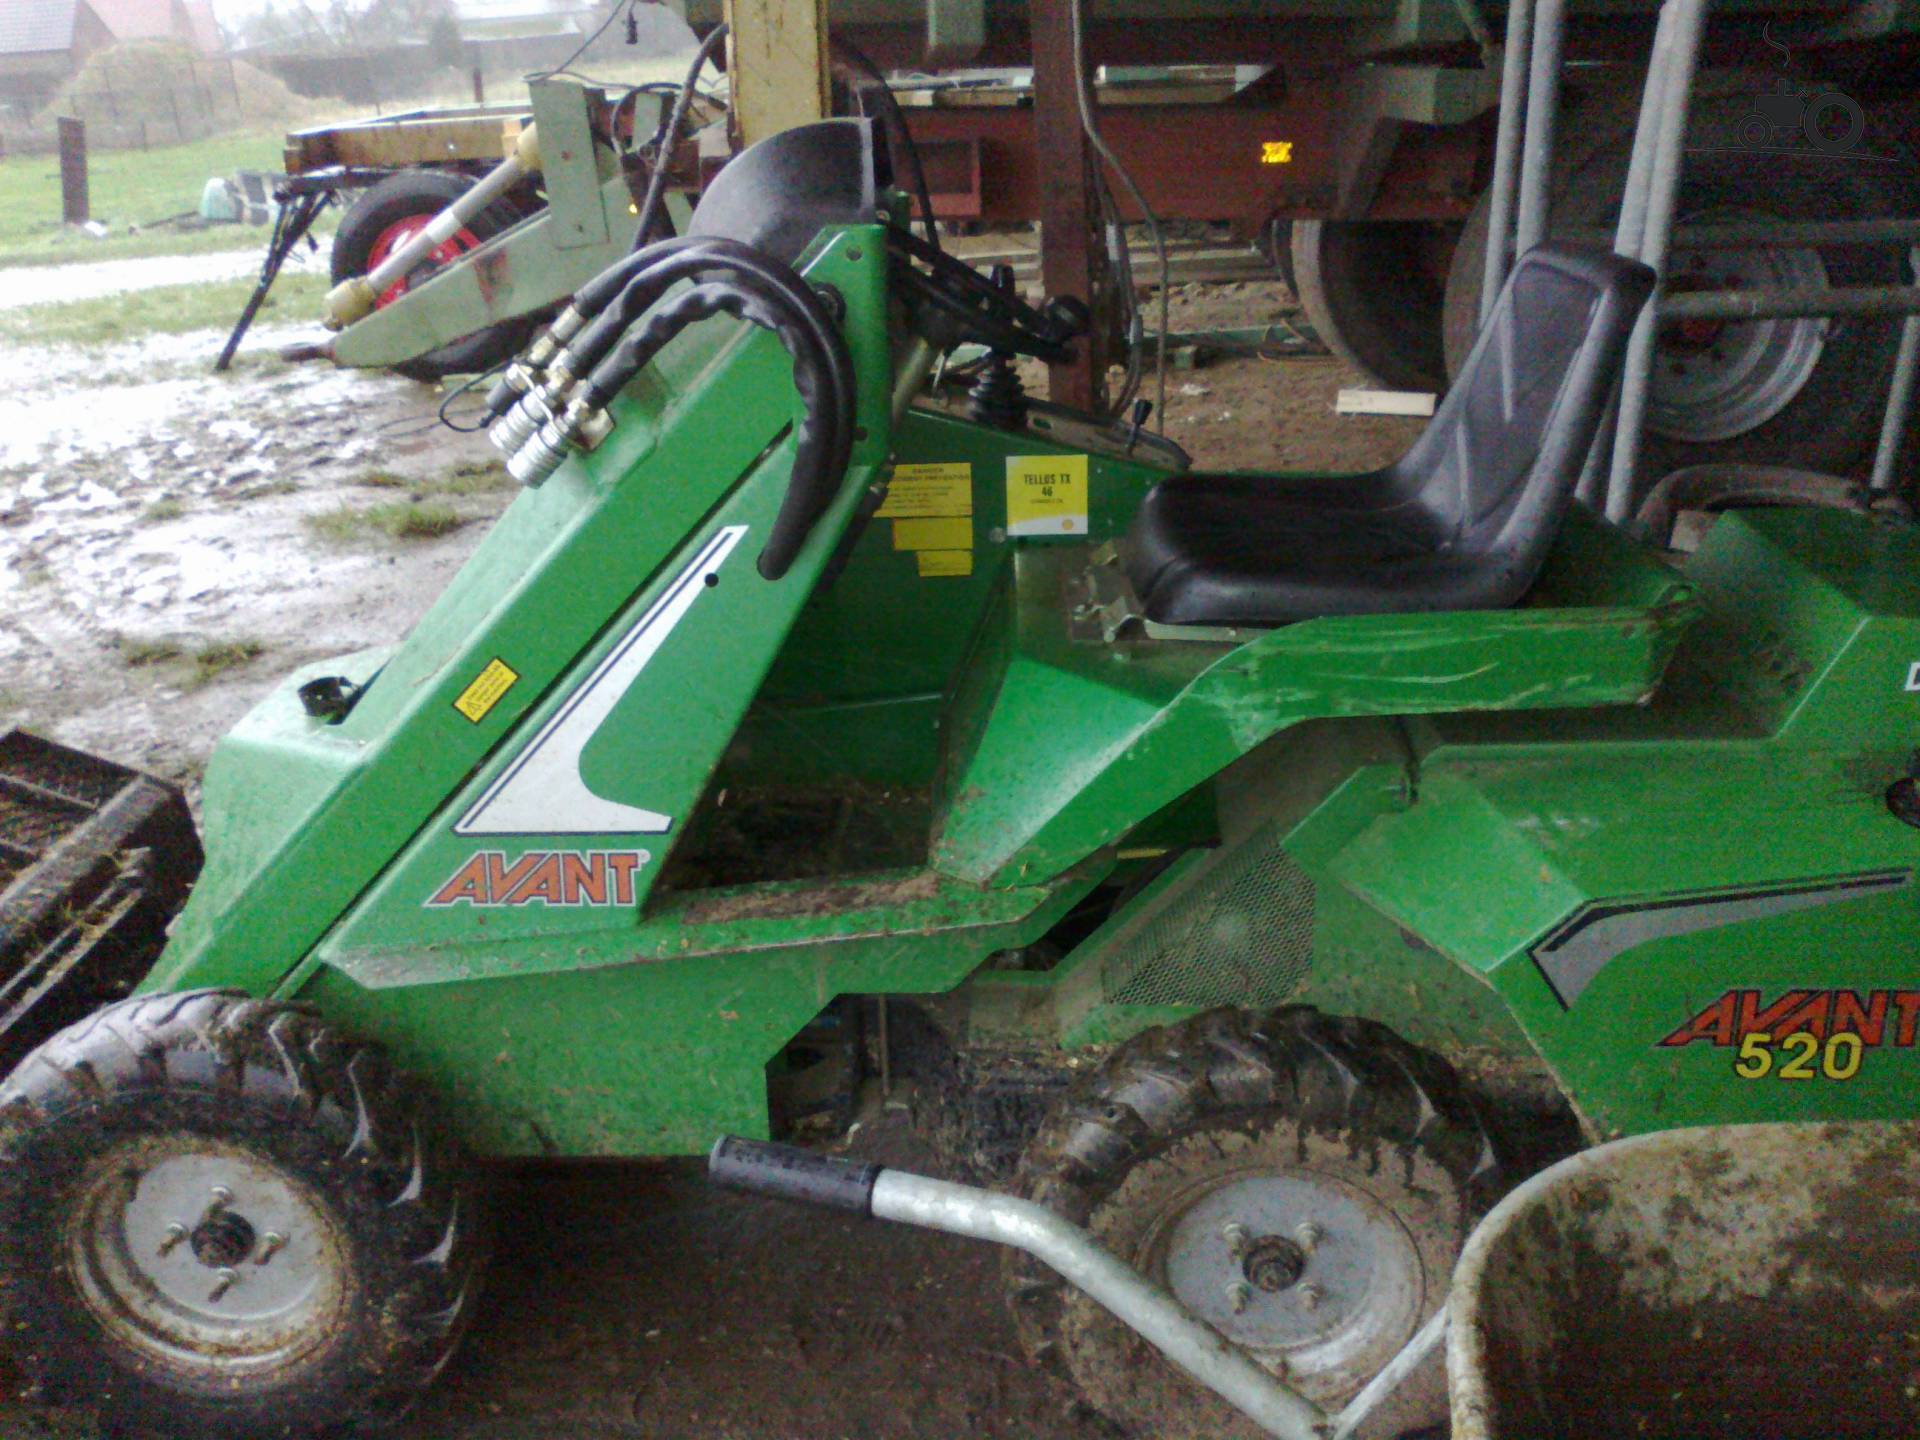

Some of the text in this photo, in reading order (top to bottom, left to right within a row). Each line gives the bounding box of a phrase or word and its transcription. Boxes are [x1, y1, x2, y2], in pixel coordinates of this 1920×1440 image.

[1023, 473, 1072, 485] TELLUS TX
[1041, 486, 1053, 497] 46
[424, 850, 641, 905] AVANT
[1654, 989, 1920, 1047] AVANT
[1735, 1031, 1864, 1080] 520
